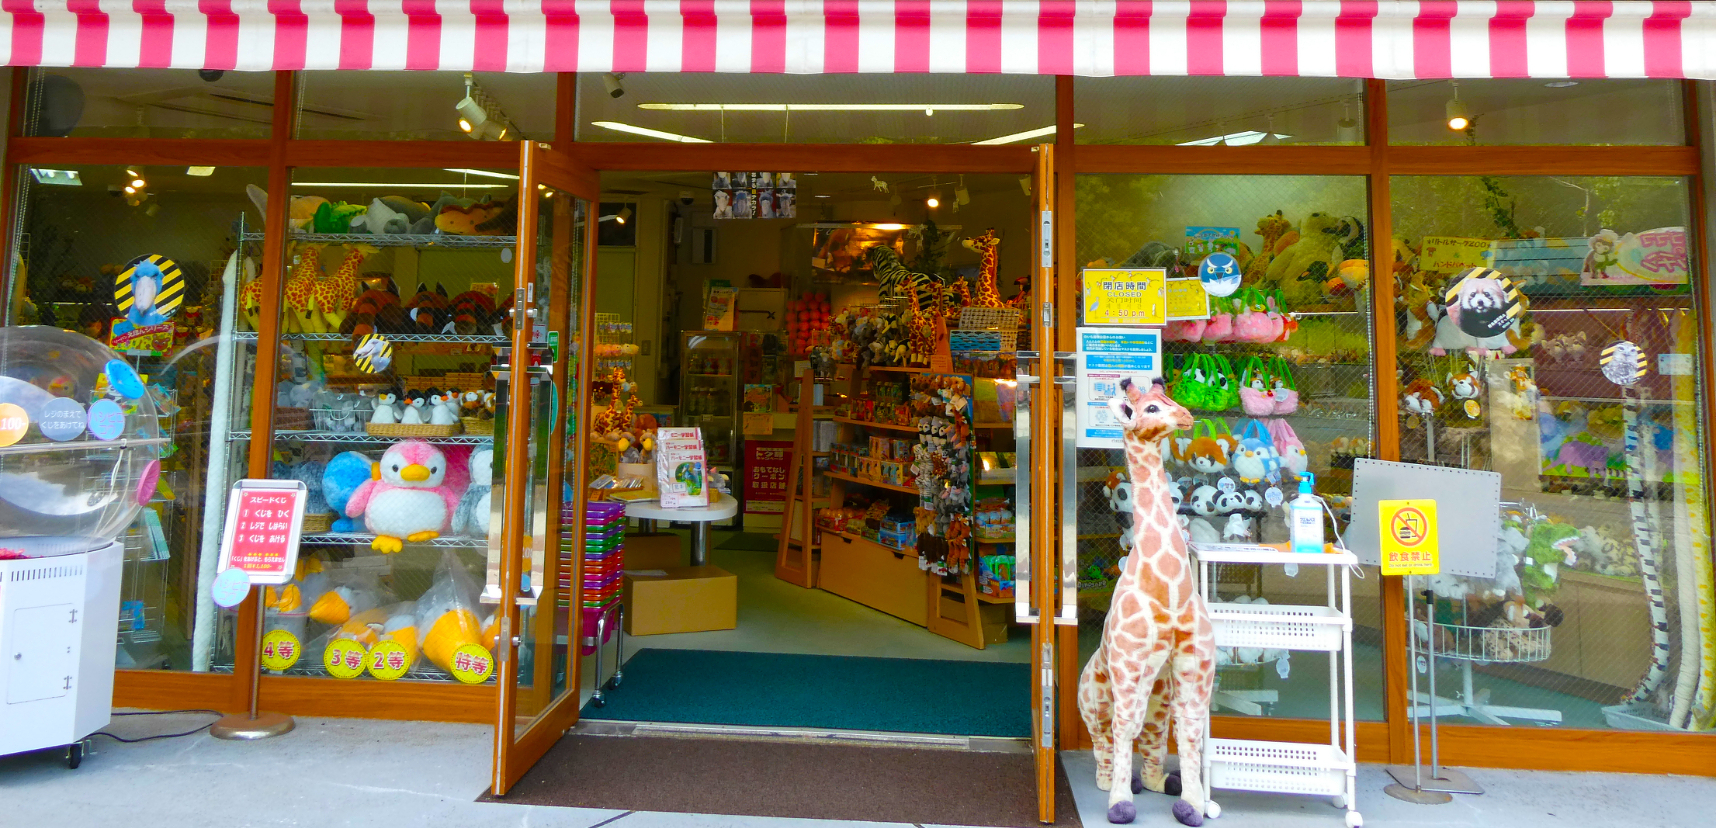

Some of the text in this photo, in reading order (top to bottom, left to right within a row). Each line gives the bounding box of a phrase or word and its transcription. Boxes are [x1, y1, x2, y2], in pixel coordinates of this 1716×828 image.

[1103, 281, 1147, 290] 閉店時間
[41, 420, 85, 430] くじをあけてね
[249, 496, 287, 504] スピードくじ
[255, 510, 272, 518] くじを
[277, 510, 290, 518] ひく
[250, 522, 265, 530] レジで
[268, 522, 288, 531] しはらい
[249, 534, 265, 543] くじを
[269, 534, 286, 543] あける
[1389, 551, 1431, 561] 飲食禁止
[263, 641, 294, 659] 4等
[331, 648, 363, 668] 3等
[373, 651, 404, 669] 2等
[455, 651, 489, 675] 特等
